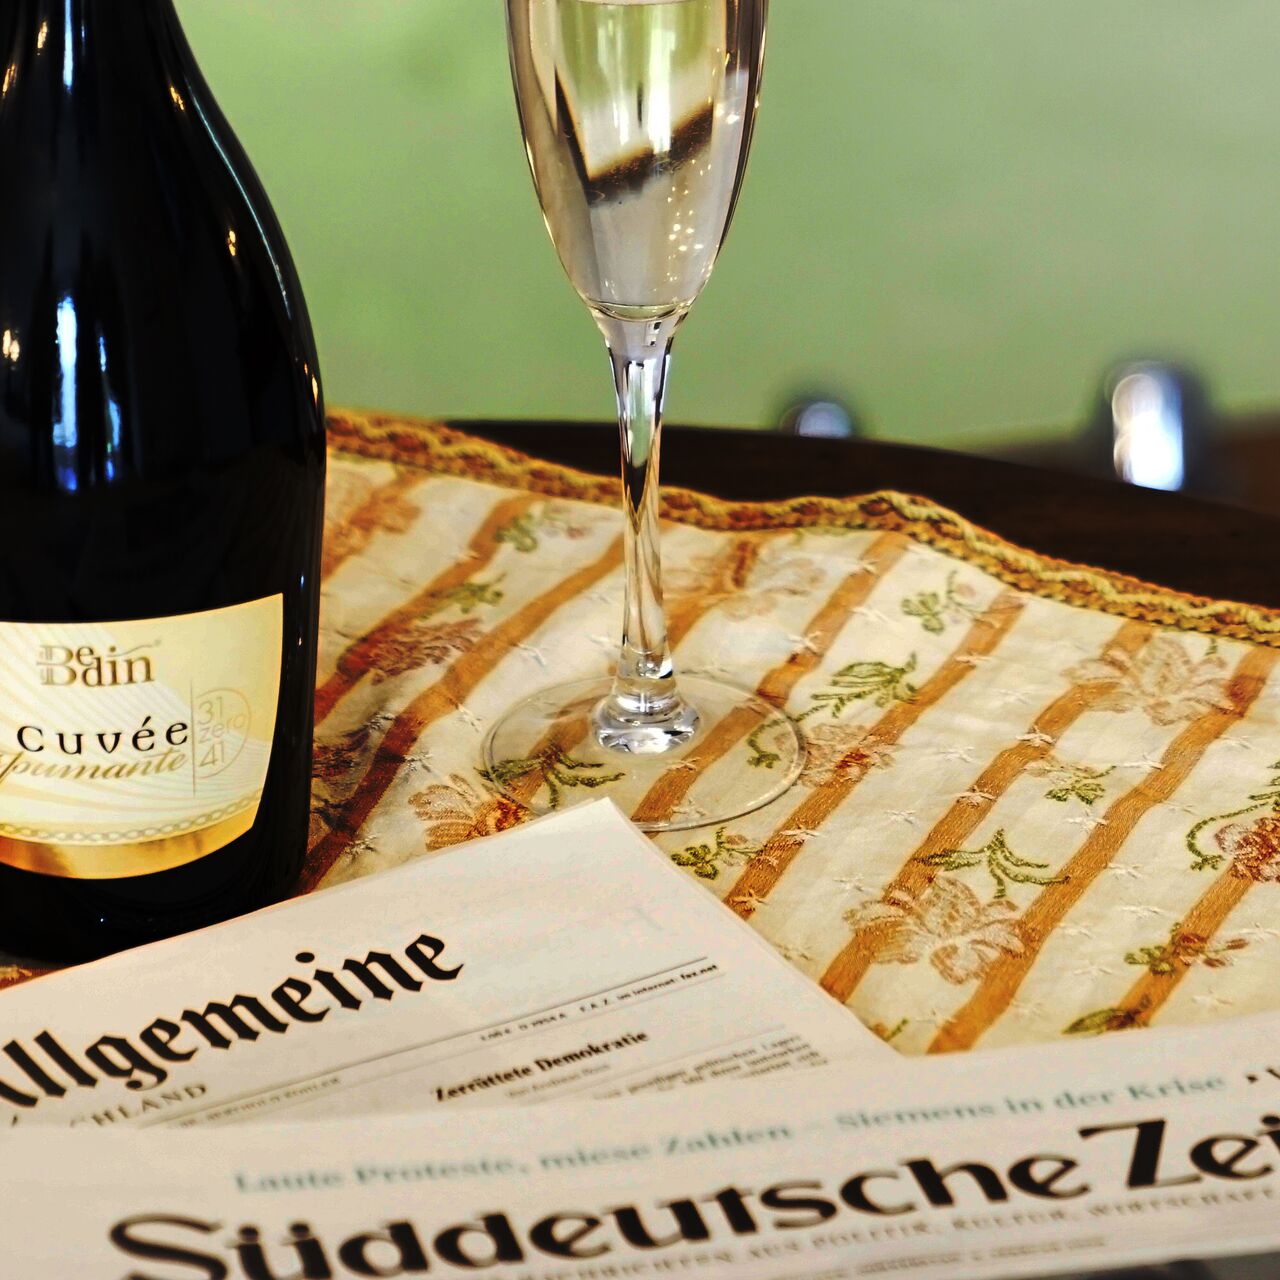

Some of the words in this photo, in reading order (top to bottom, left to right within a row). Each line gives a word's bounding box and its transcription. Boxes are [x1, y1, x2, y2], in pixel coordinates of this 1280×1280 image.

[534, 1030, 649, 1071] Demokratie
[660, 1121, 794, 1157] Zahlen
[1005, 1094, 1046, 1116] in
[1052, 1084, 1116, 1111] der
[1126, 1072, 1229, 1103] Krise
[109, 1151, 1091, 1280] Süddeutsche
